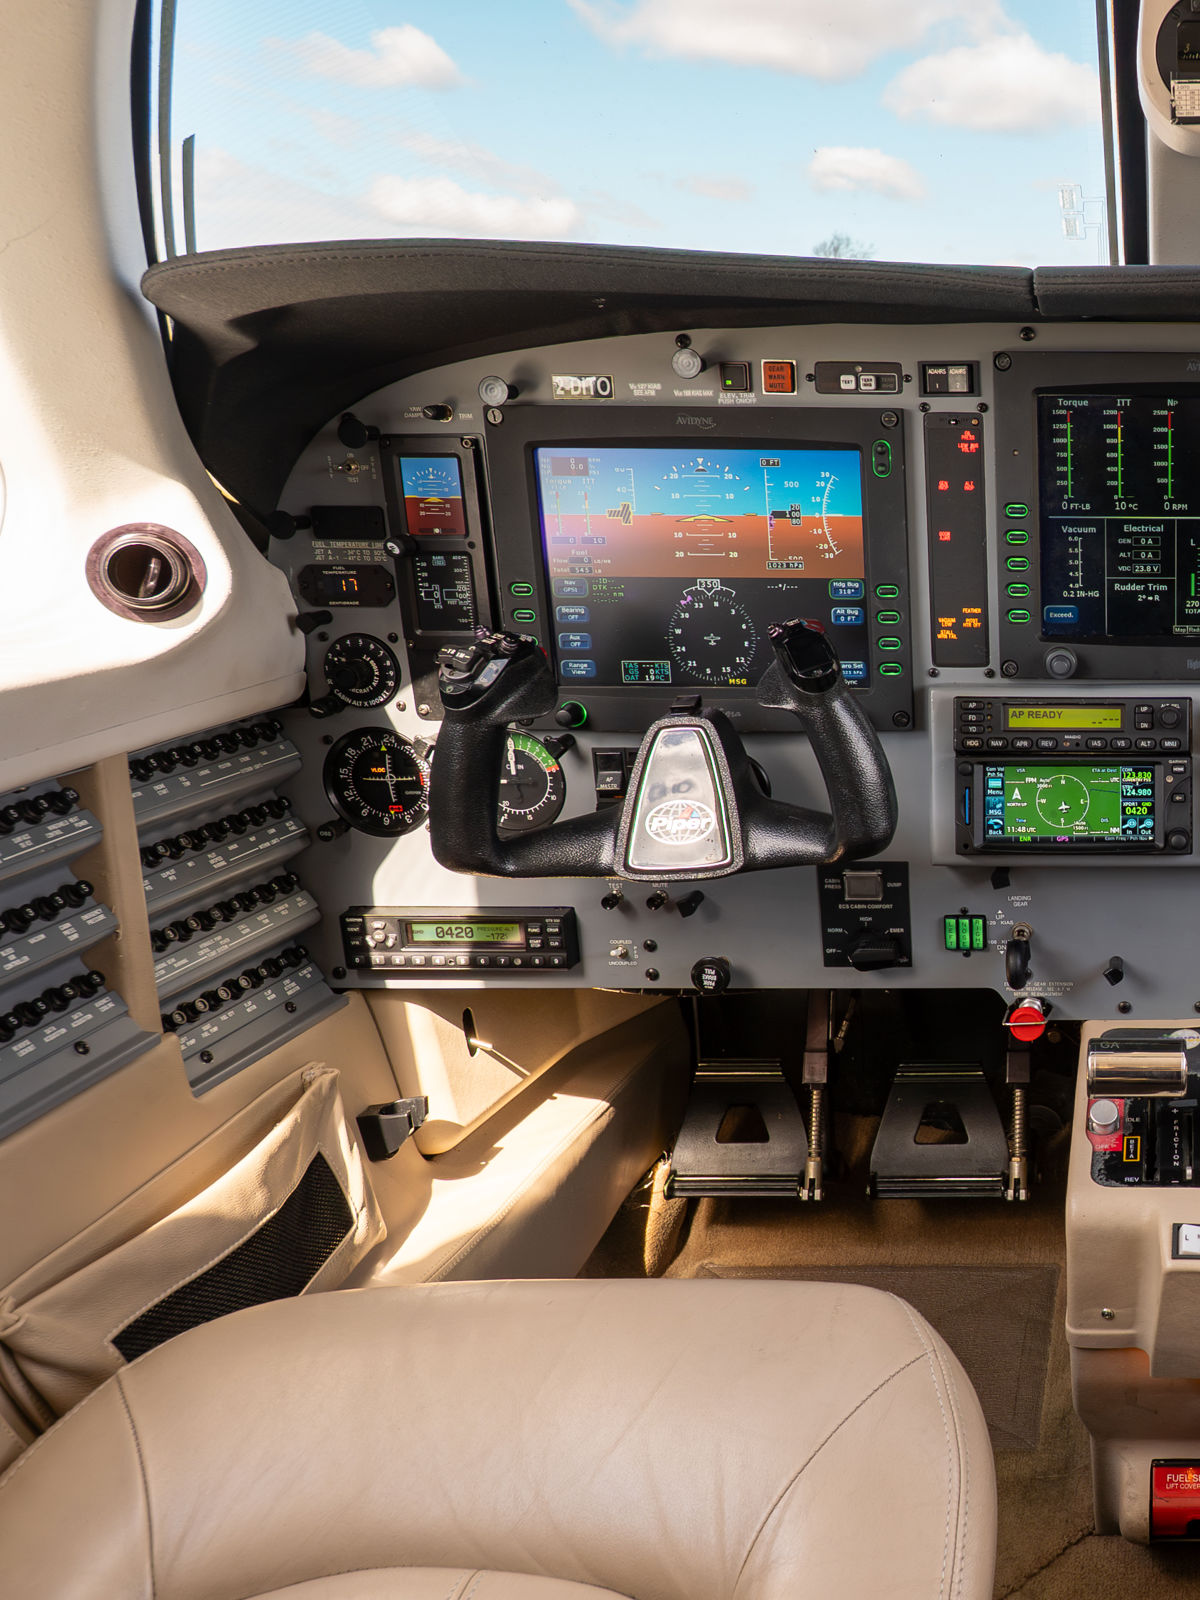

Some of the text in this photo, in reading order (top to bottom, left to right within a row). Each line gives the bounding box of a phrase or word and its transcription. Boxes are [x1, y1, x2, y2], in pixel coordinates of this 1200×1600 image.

[1058, 399, 1088, 408] Torque
[676, 416, 714, 425] AVIDYNE
[1124, 524, 1164, 532] Electrical
[342, 578, 358, 592] 17
[1011, 710, 1064, 719] AP READY
[361, 736, 372, 746] 21
[384, 734, 394, 743] 24
[650, 816, 712, 834] Piper
[435, 926, 474, 938] 0420
[1166, 1474, 1189, 1482] FUEL
